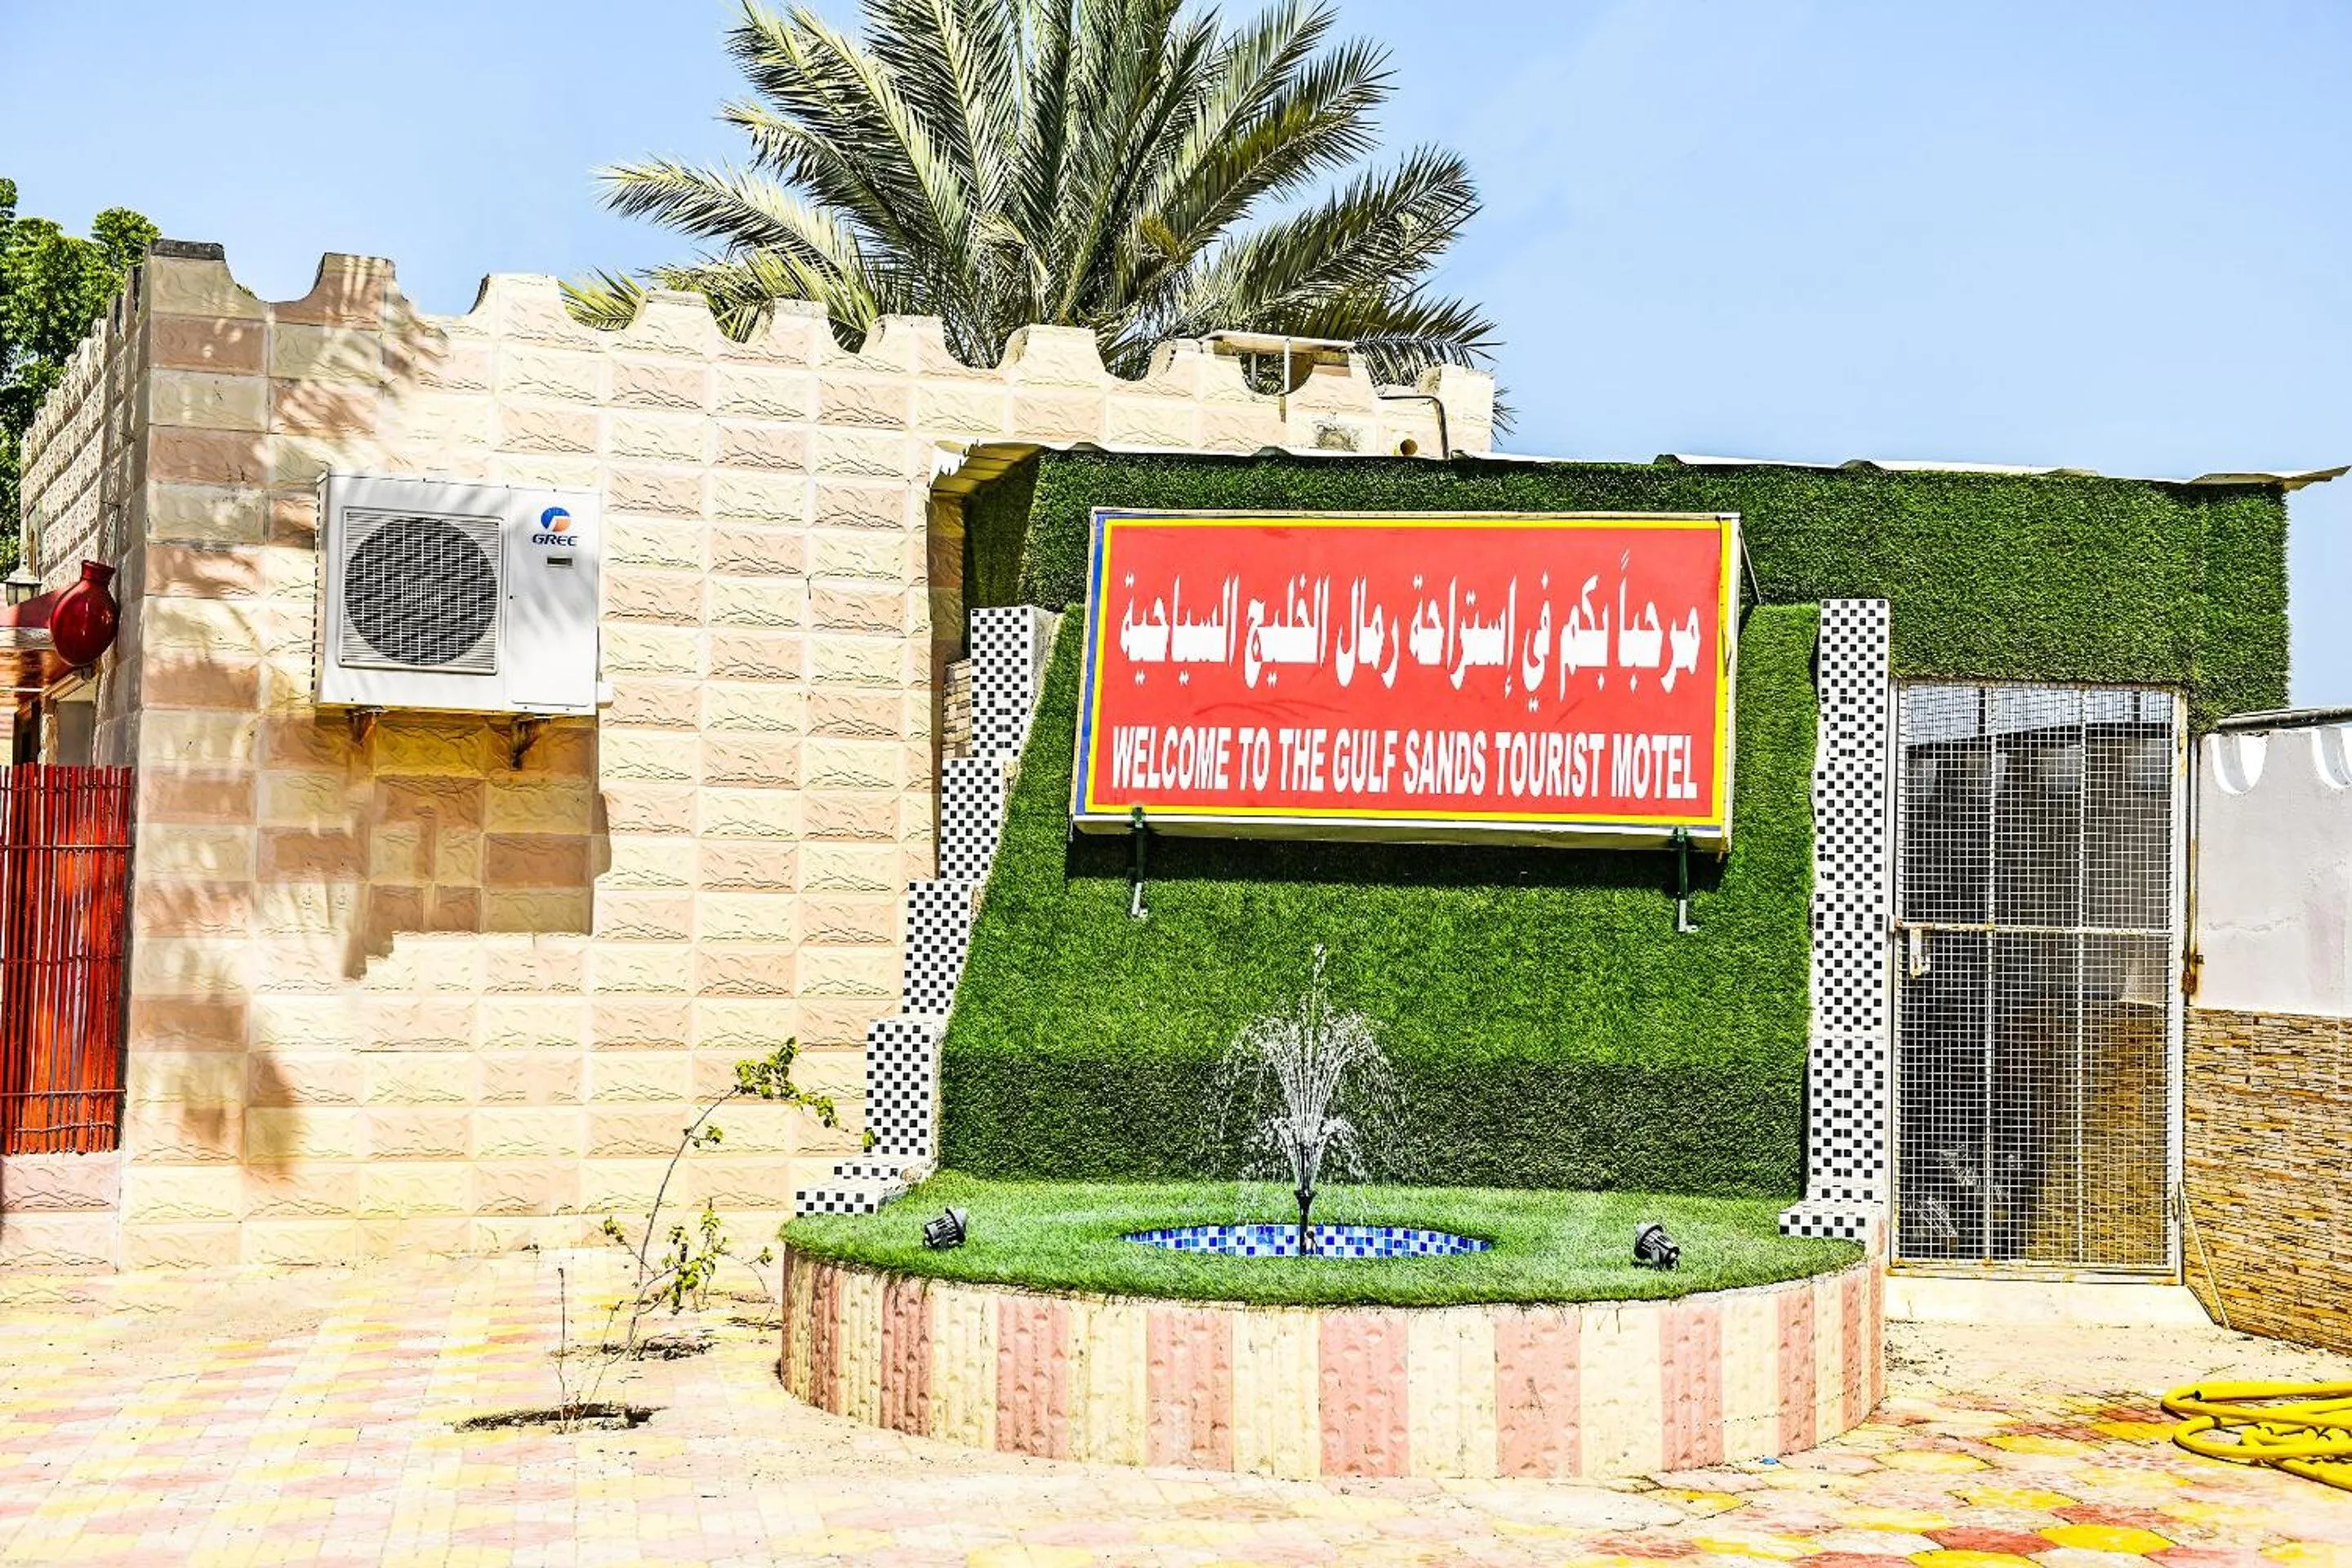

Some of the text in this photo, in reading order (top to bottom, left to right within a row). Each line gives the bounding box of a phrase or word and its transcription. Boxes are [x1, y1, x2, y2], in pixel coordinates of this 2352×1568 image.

[1120, 573, 1239, 685] السياحية
[1244, 575, 1330, 688] الخليج
[1336, 576, 1399, 689] رمال
[1409, 574, 1517, 699] إستراحة
[1521, 572, 1551, 712] في
[1560, 574, 1609, 702] بكم
[1112, 725, 1698, 800] WELCOME TO THE GULF SANDS TOURIST MOTEL
